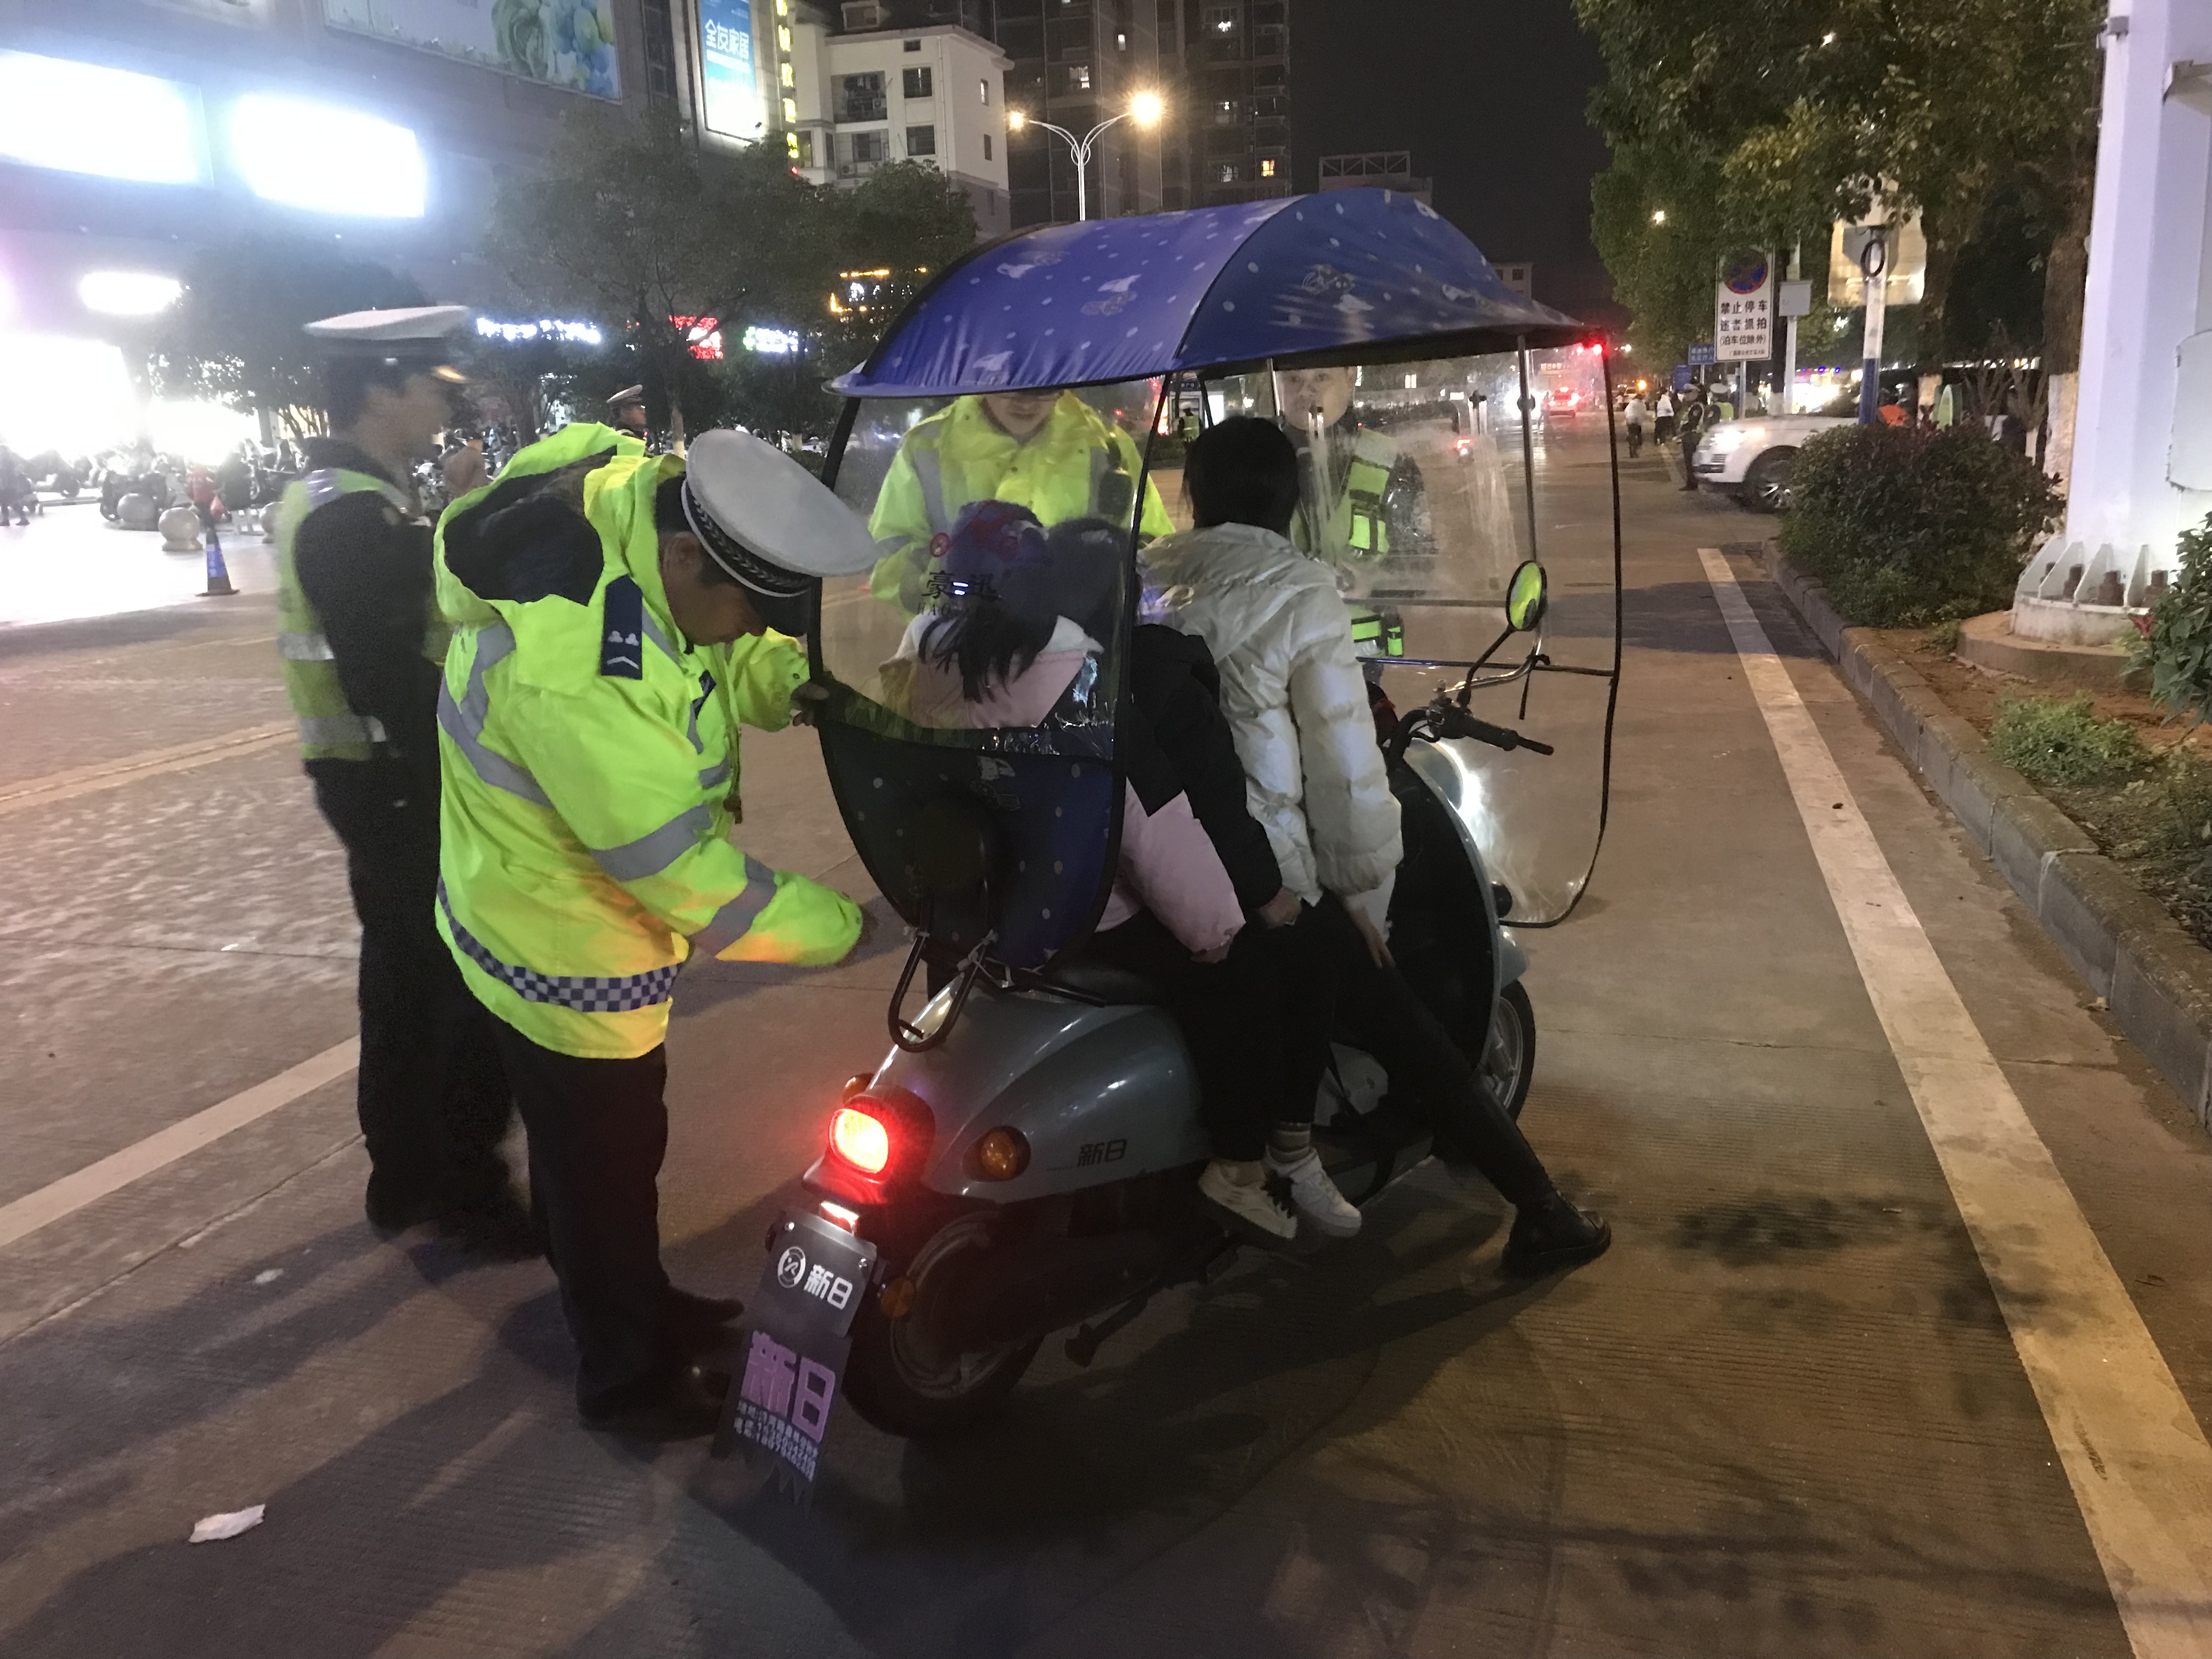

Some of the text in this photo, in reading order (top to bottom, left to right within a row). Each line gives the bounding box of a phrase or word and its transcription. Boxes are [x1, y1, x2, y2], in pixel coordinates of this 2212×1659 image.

[704, 19, 749, 60] 全友家居
[1720, 317, 1767, 331] 违者抓拍
[1721, 300, 1768, 314] 禁止停车
[1076, 1138, 1127, 1168] 新日
[803, 1264, 853, 1310] 新日
[741, 1330, 836, 1442] 新日
